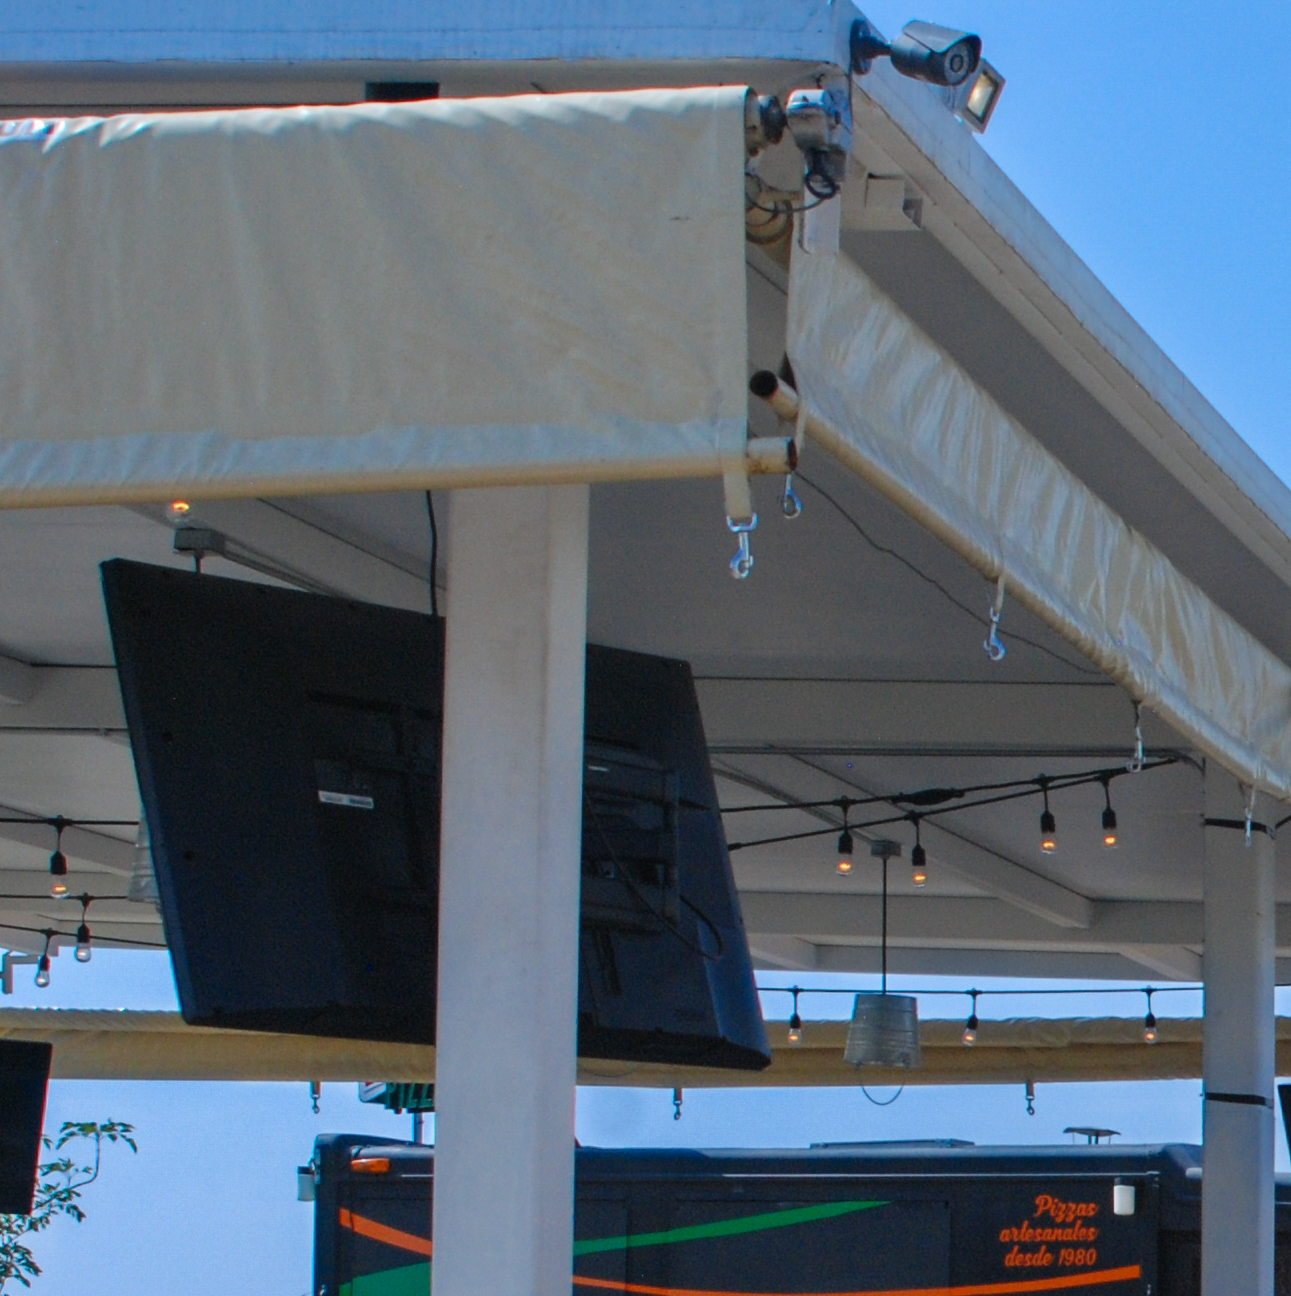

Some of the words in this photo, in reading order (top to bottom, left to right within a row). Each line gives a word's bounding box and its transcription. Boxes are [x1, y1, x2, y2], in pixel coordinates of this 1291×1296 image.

[1034, 1194, 1099, 1222] Pizzas
[999, 1220, 1099, 1242] artesanales
[1004, 1245, 1055, 1267] desde
[1058, 1248, 1097, 1266] 1980
